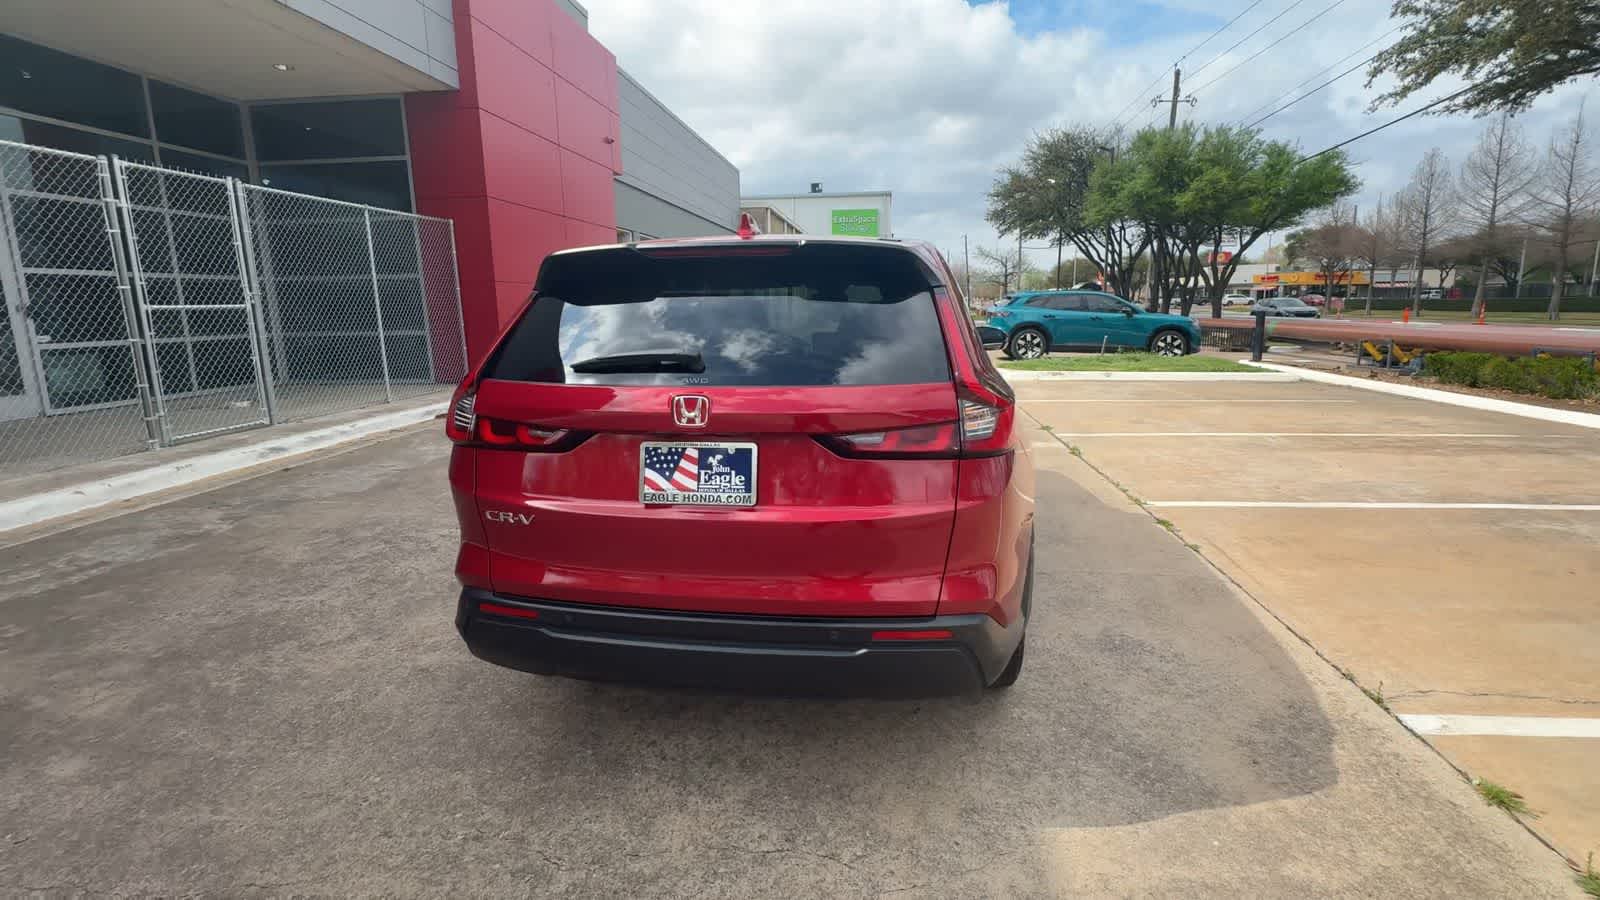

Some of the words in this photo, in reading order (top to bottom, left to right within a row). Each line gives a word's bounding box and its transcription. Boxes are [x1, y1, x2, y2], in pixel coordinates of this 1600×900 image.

[711, 464, 730, 474] John
[699, 469, 745, 489] Eagle
[643, 493, 679, 502] EAGLE
[683, 494, 752, 504] HONDA.COM
[485, 510, 535, 525] CR-V
